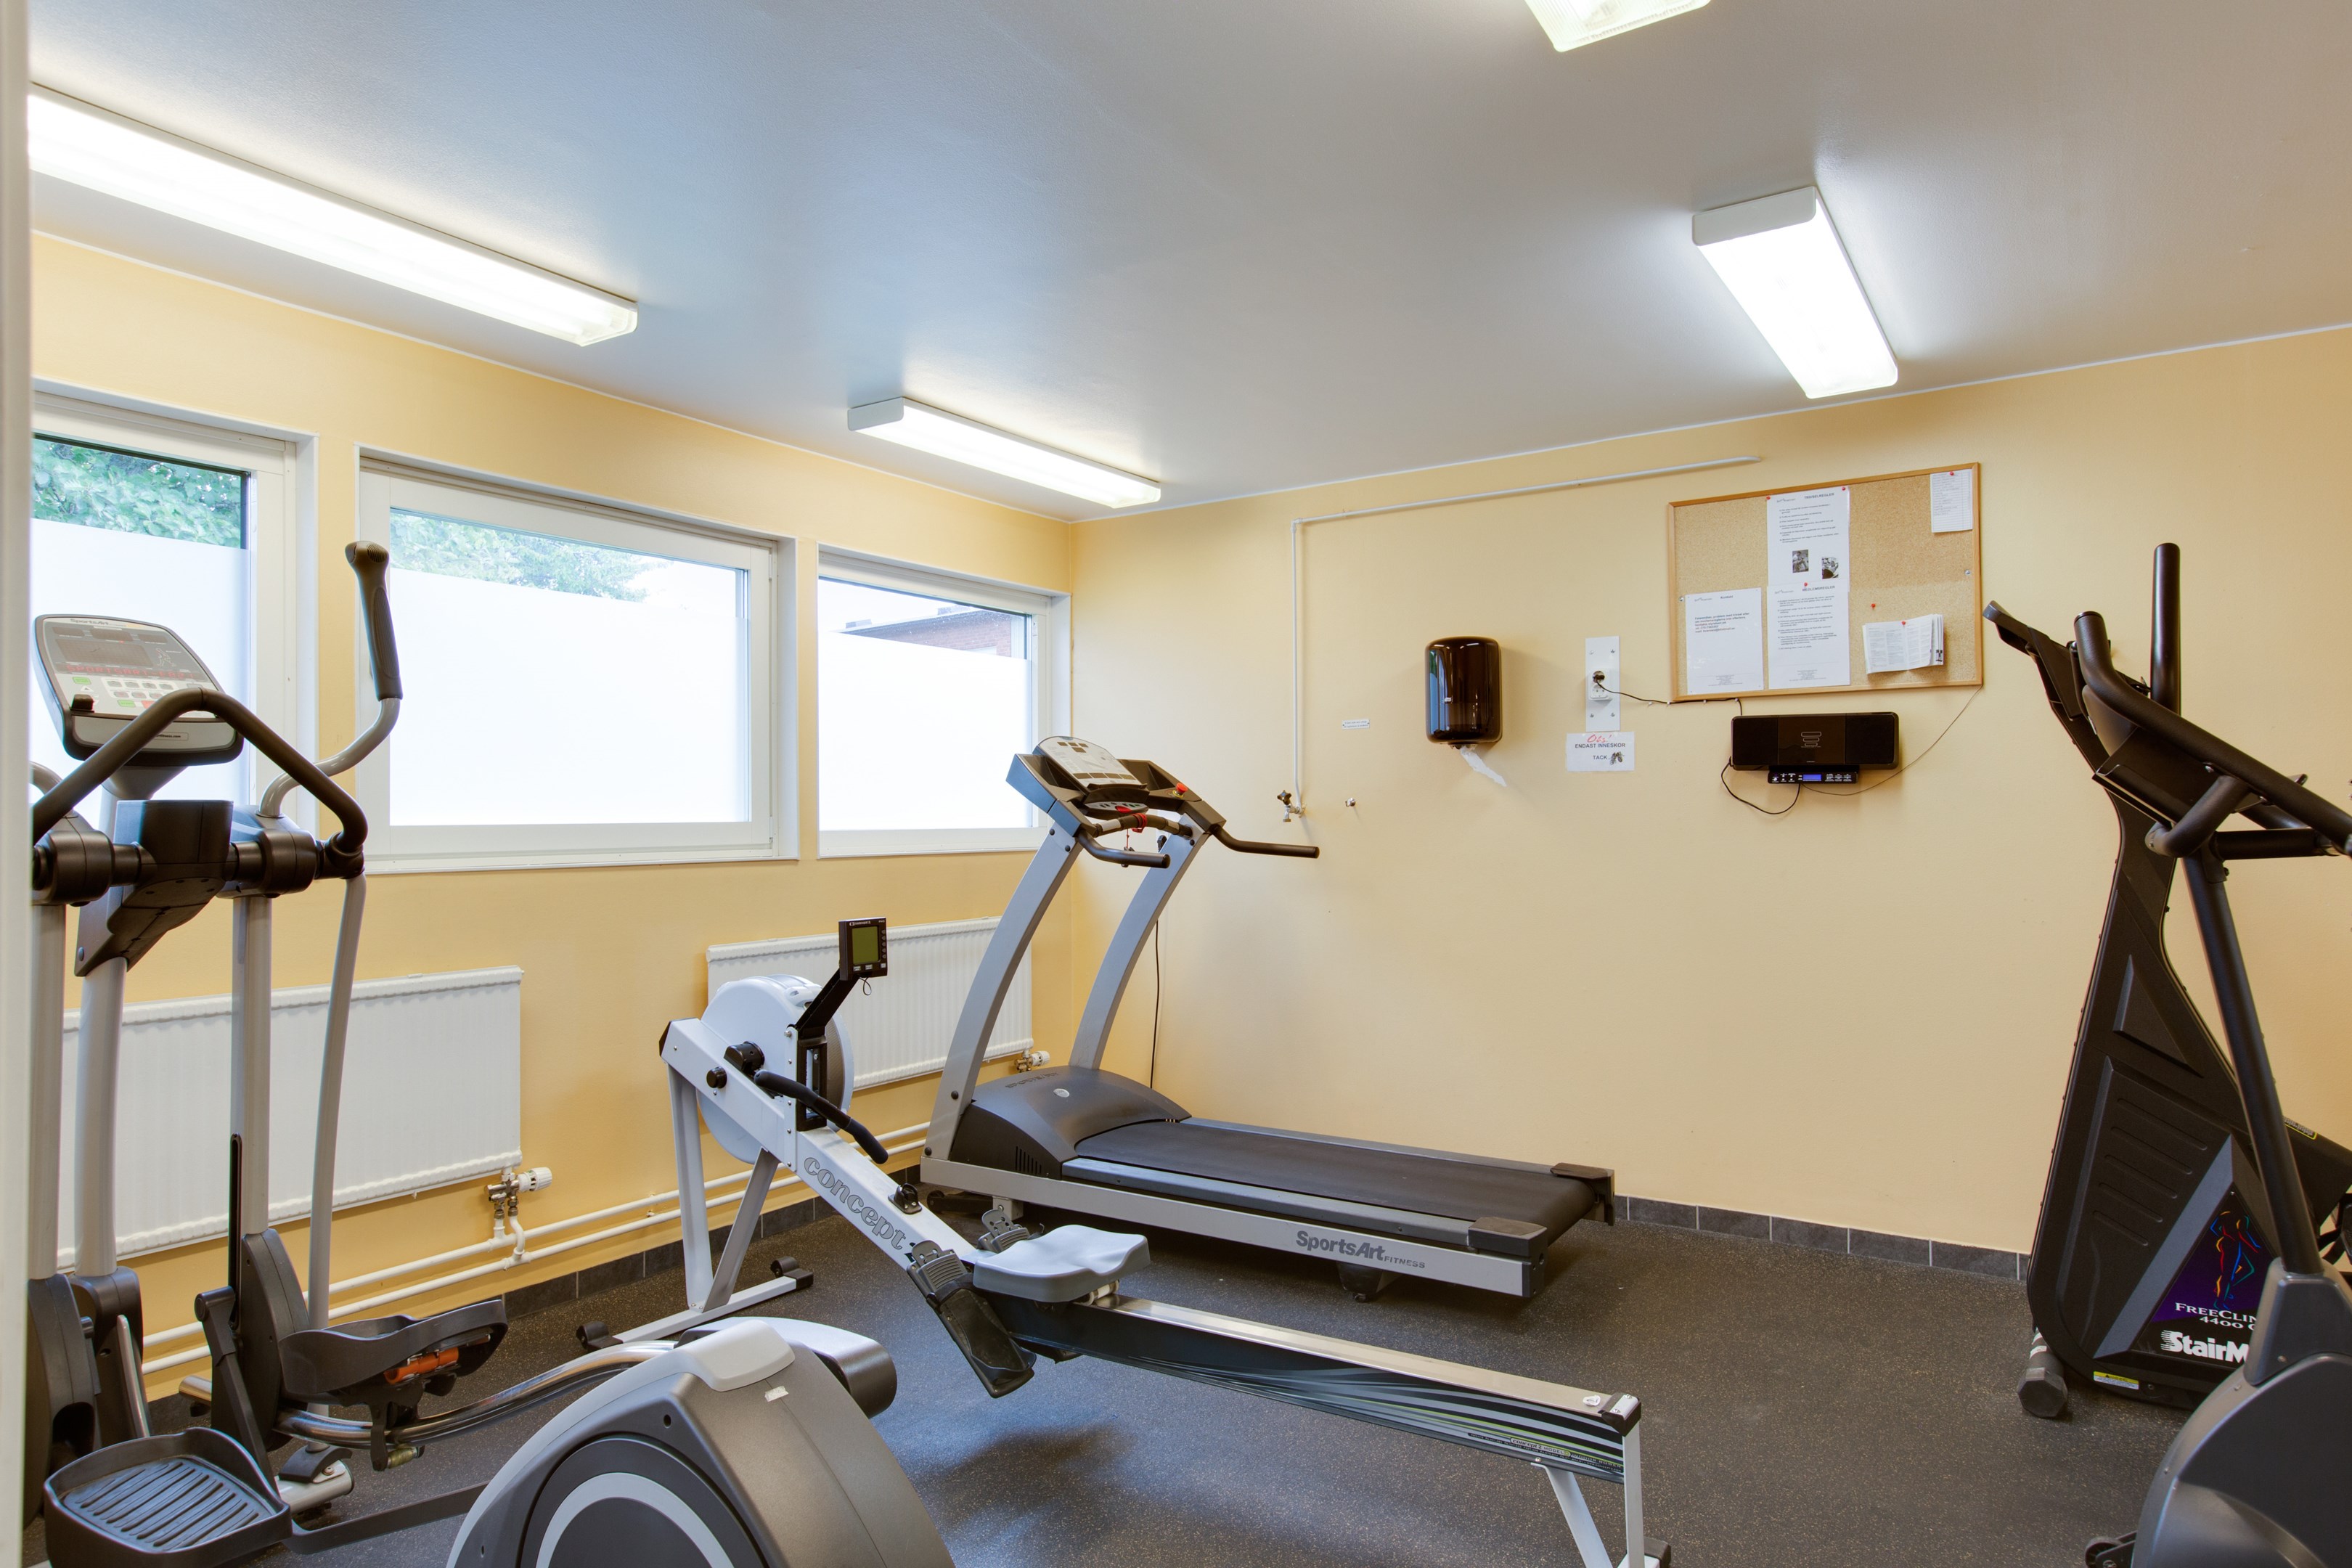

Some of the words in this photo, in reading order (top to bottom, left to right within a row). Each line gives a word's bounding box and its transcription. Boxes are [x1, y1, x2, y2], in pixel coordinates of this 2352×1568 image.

[804, 1157, 907, 1250] concept
[1296, 1230, 1386, 1261] SportsArt
[1384, 1256, 1425, 1268] FITNESS
[2199, 1315, 2244, 1329] 4400
[1543, 1446, 1564, 1455] MODEL
